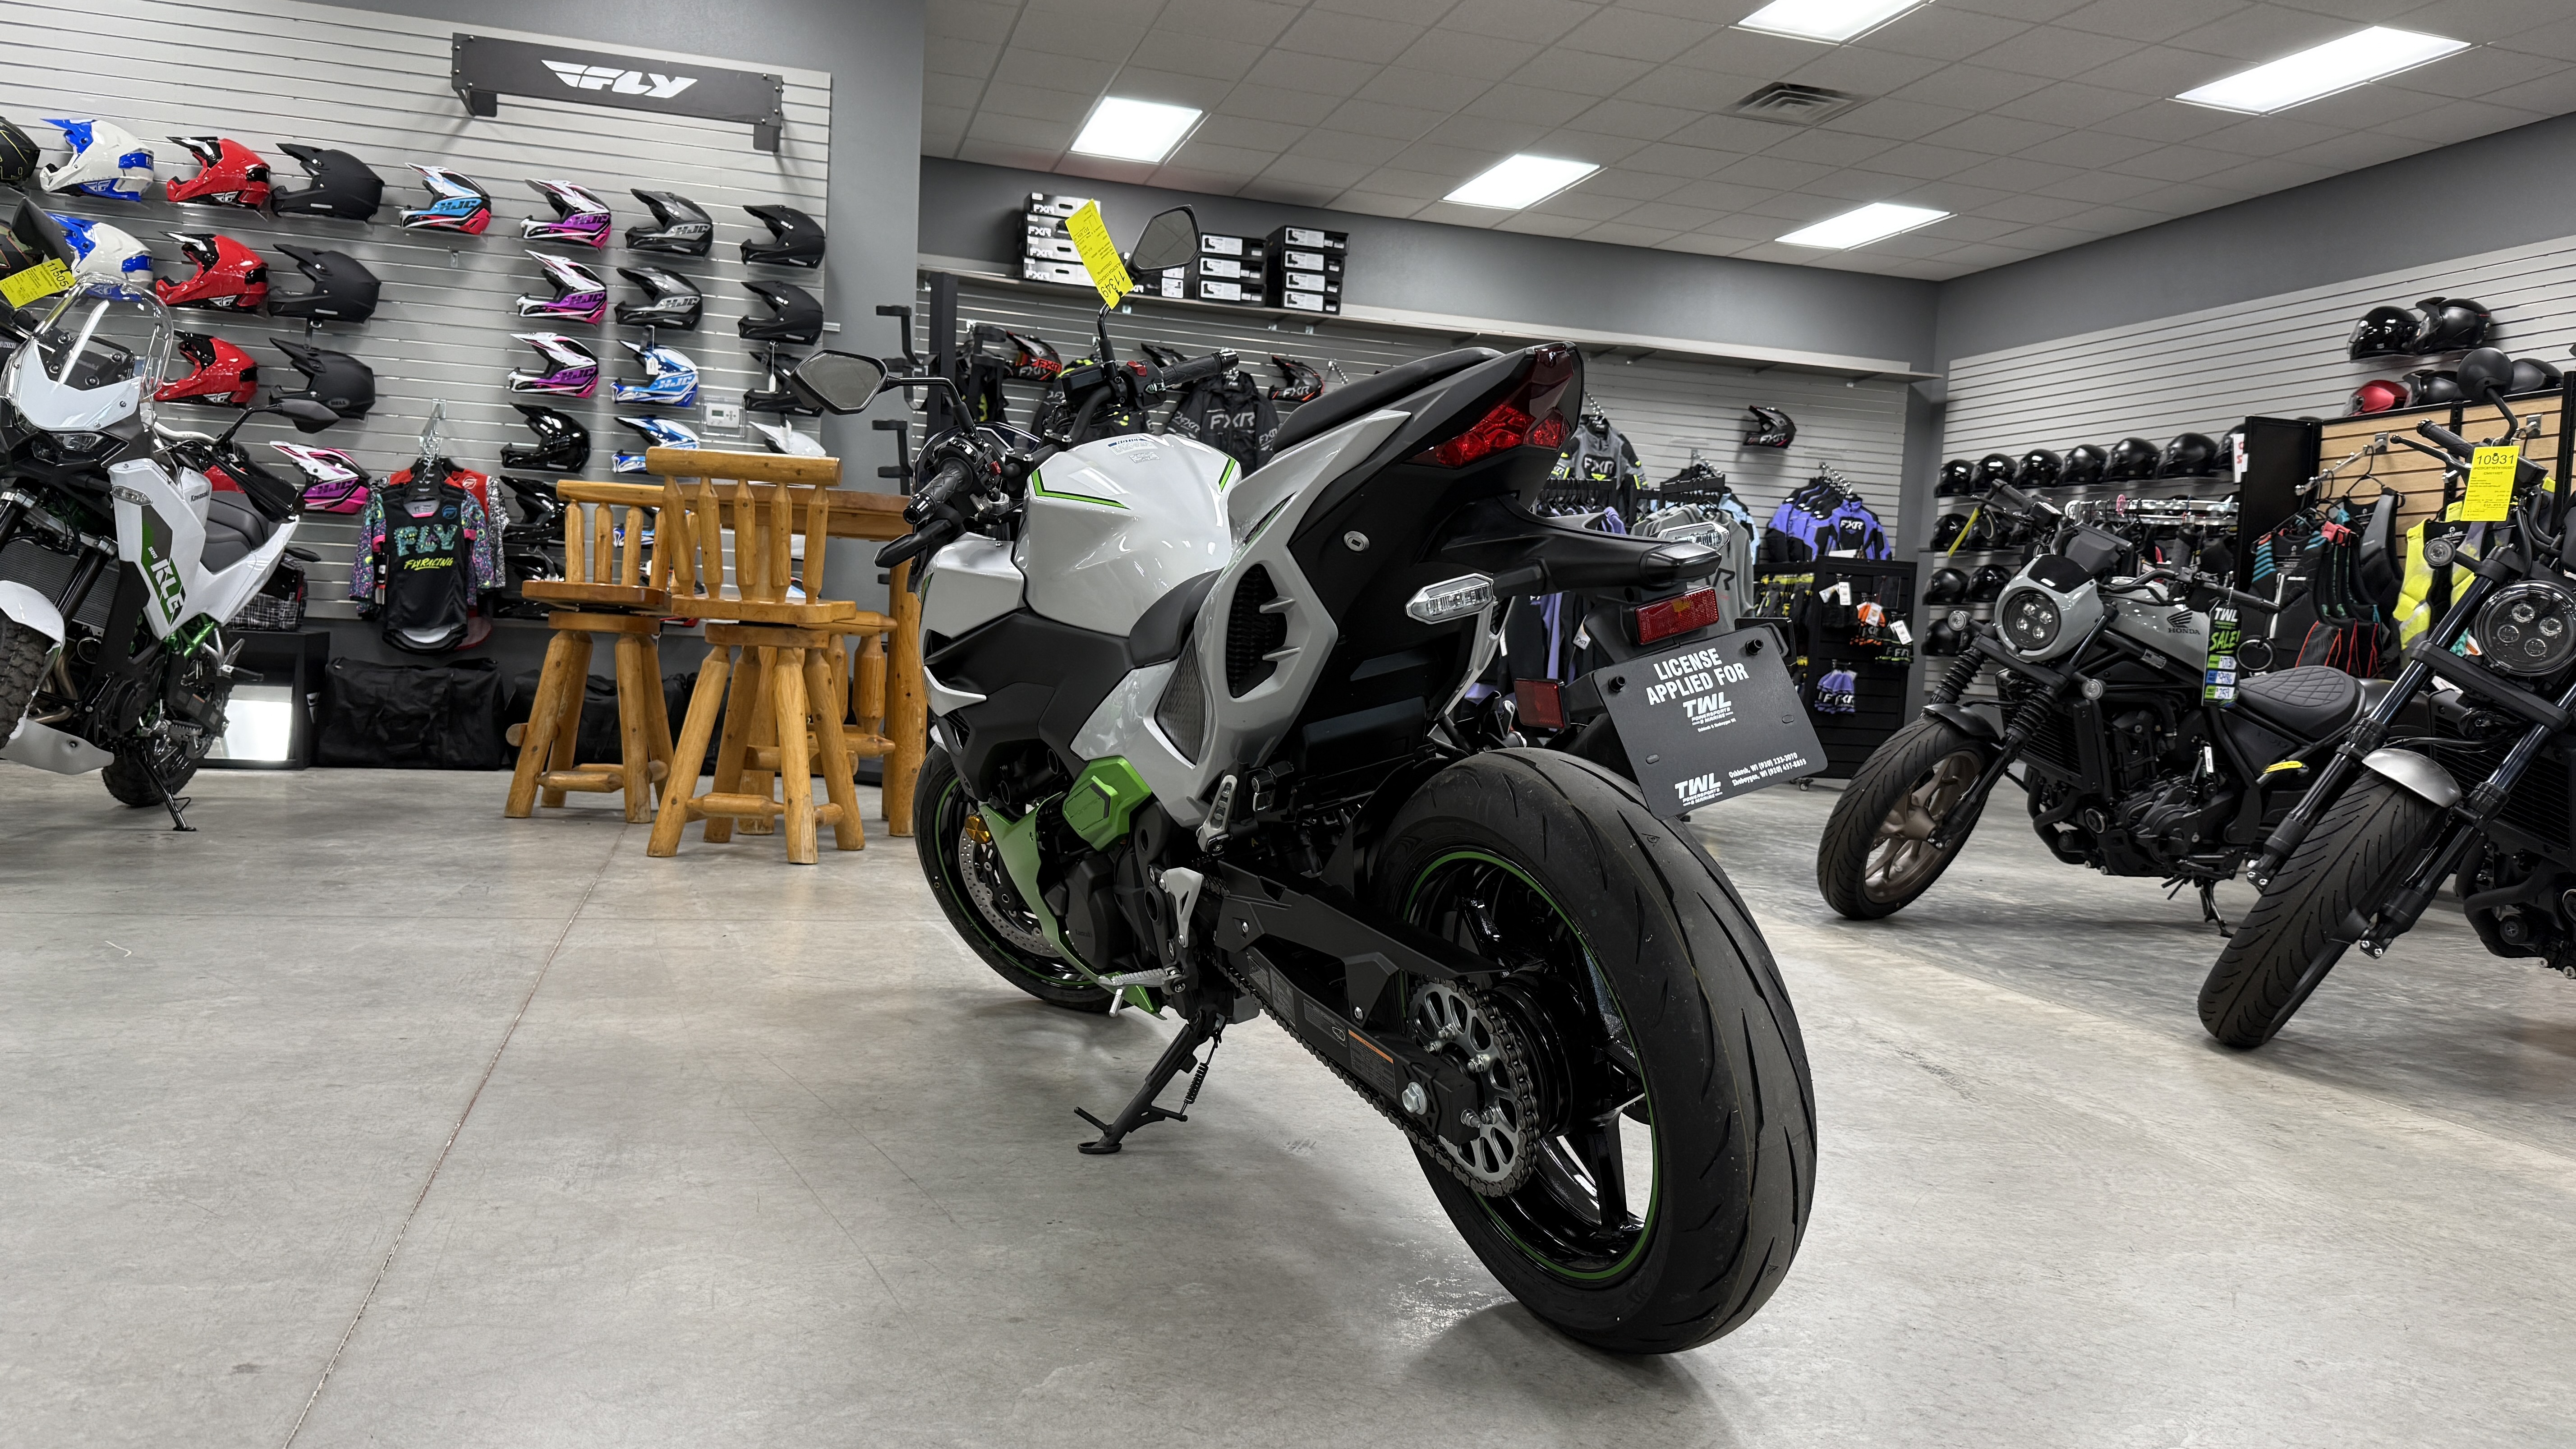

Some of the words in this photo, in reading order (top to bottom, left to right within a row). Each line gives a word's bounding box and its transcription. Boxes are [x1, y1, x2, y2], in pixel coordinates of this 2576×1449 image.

[559, 63, 698, 98] FLY
[439, 200, 477, 211] HJC
[1033, 204, 1054, 214] FXR
[575, 215, 608, 225] HJC
[677, 225, 708, 235] HJC
[1028, 225, 1051, 237] FXR
[1030, 248, 1053, 258] FXR
[47, 262, 69, 287] 11505
[1026, 270, 1050, 280] FXR
[1101, 271, 1125, 298] 11349
[570, 293, 604, 304] HJC
[665, 298, 697, 308] HJC
[561, 368, 593, 380] HJC
[659, 376, 692, 388] HJC
[1283, 386, 1310, 397] FXR
[1210, 412, 1256, 429] FXR
[1584, 457, 1615, 474] FXR
[2476, 454, 2514, 465] 10931
[317, 480, 353, 494] HJC
[191, 490, 210, 502] Kawasaki
[1840, 520, 1863, 530] FXR
[394, 524, 458, 557] FLY
[2214, 607, 2238, 622] TWL
[2209, 630, 2240, 651] SALE!
[1653, 648, 1722, 681] LICENSE
[1646, 672, 1713, 705] APPLIED
[1713, 662, 1749, 685] FOR
[1683, 691, 1731, 718] TWL
[1750, 763, 1758, 772] WI
[1758, 759, 1773, 770] (920)
[1759, 769, 1768, 778] WI
[1768, 765, 1782, 777] (920)
[1674, 773, 1721, 799] TWL
